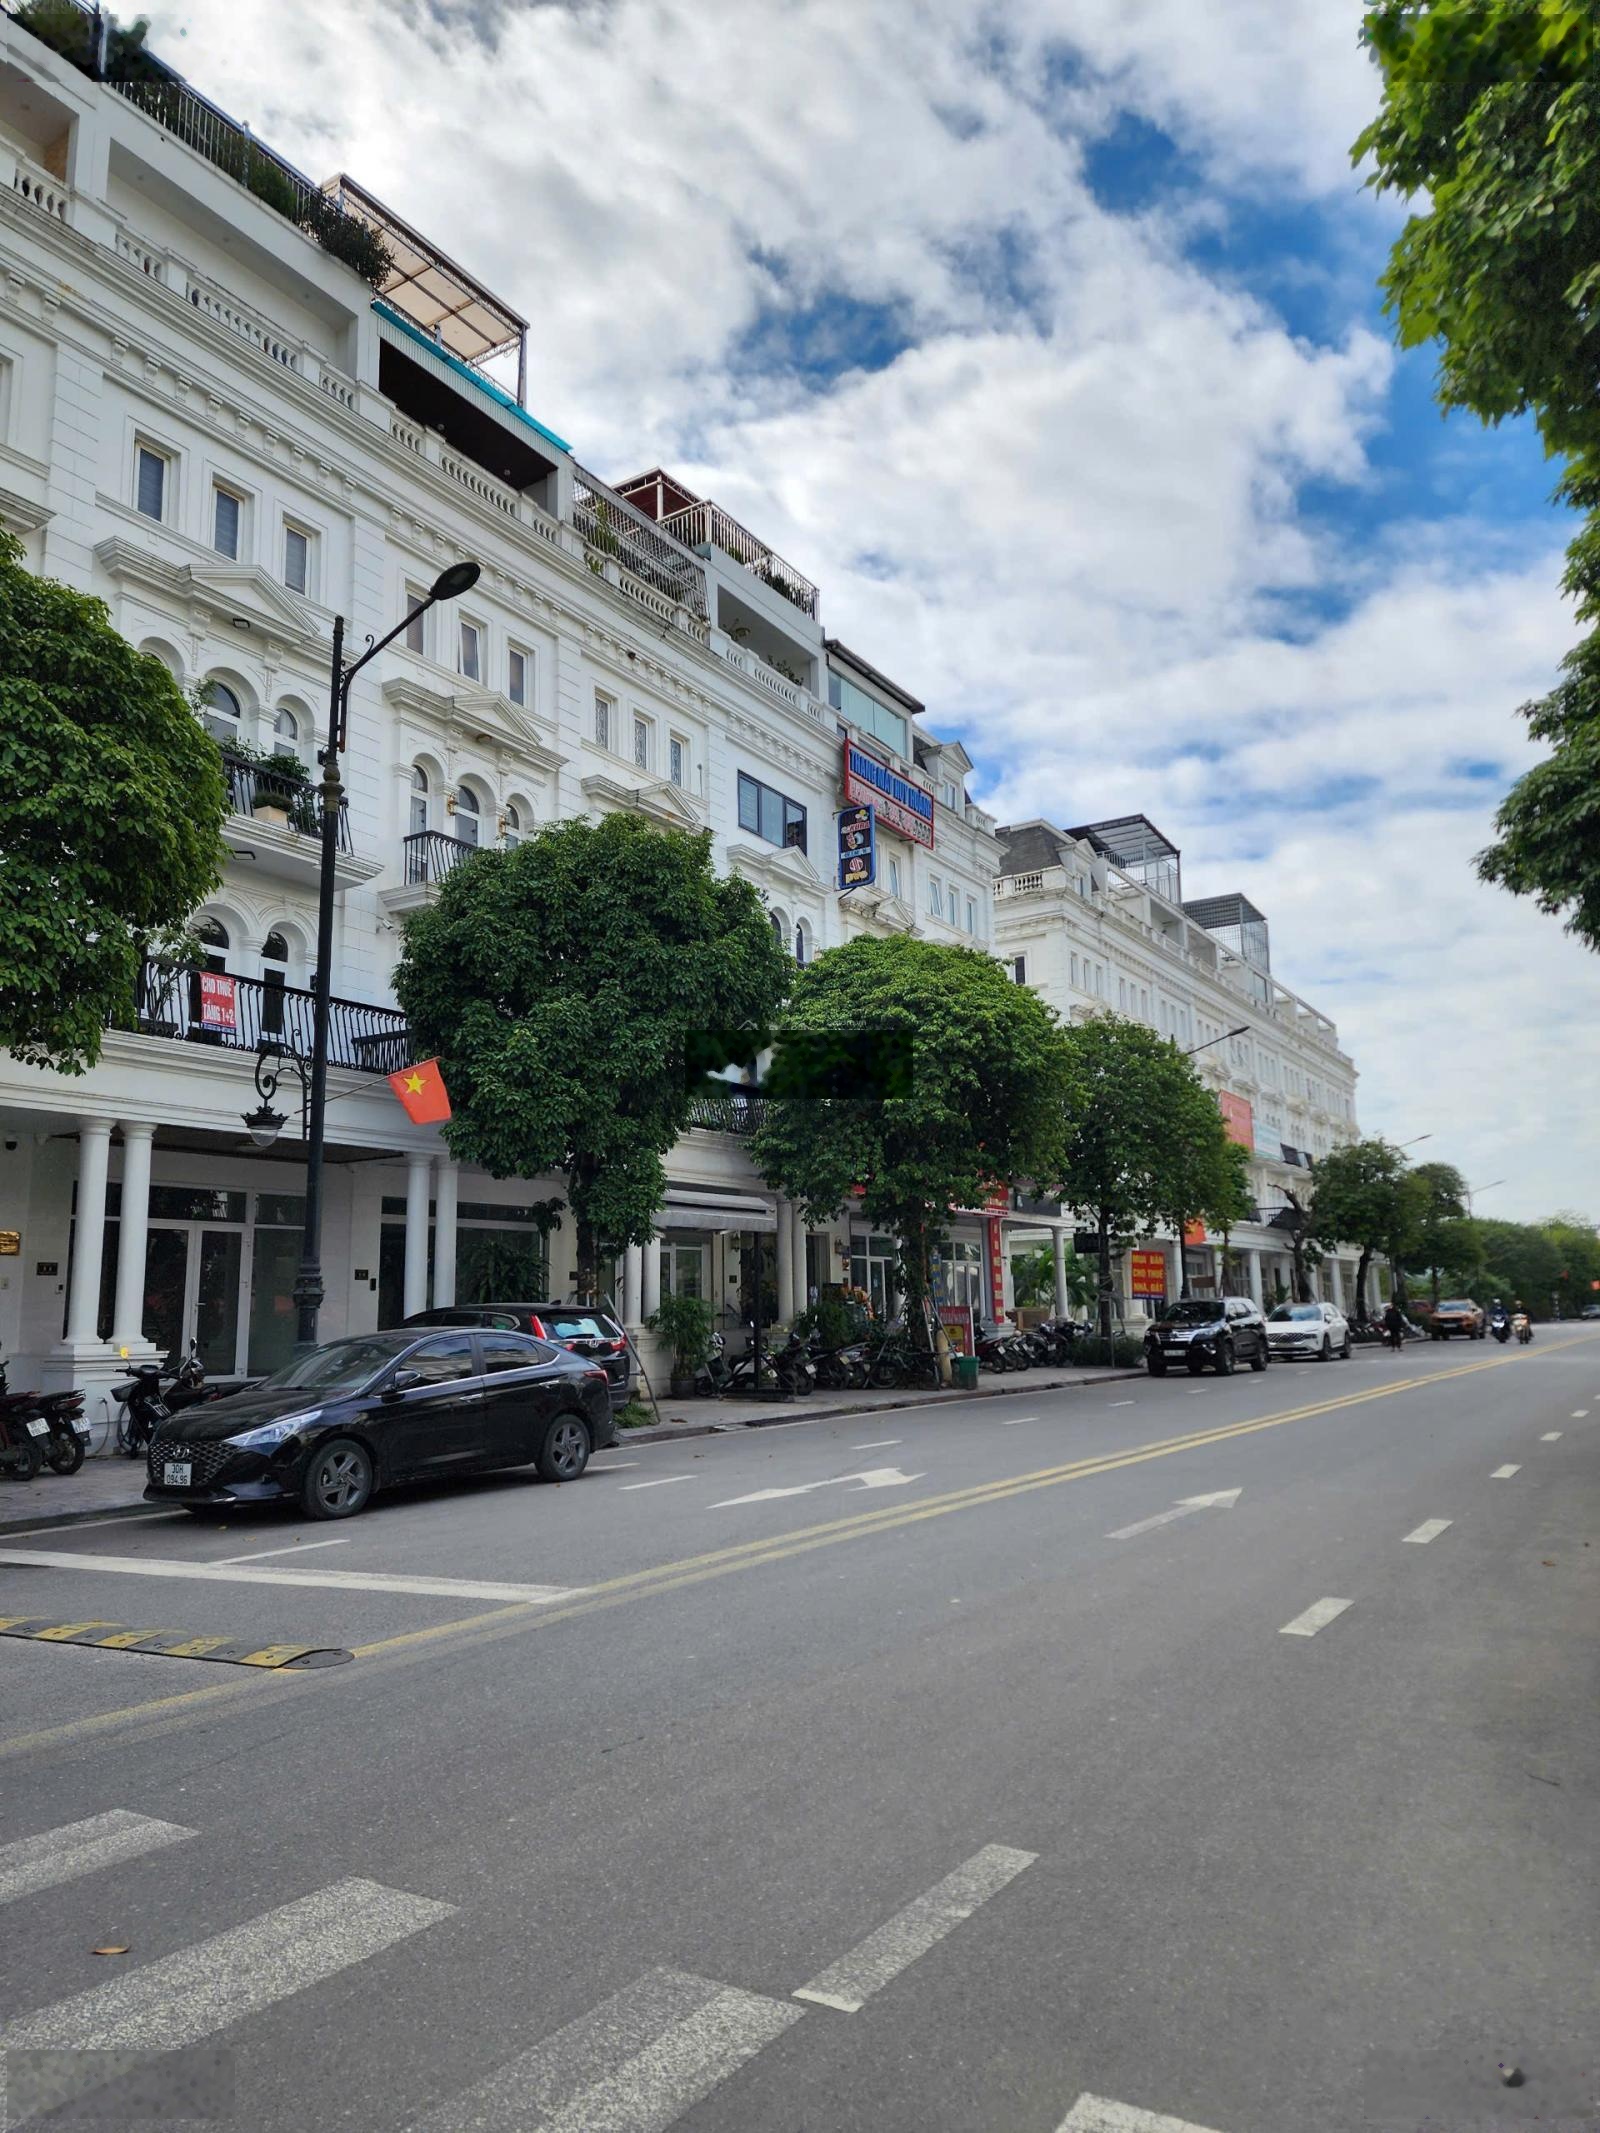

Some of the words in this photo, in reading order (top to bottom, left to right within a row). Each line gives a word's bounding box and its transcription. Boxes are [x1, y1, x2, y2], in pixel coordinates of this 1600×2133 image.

[201, 975, 216, 994] CHO
[217, 978, 233, 998] THUÊ
[221, 1006, 235, 1024] 1+2
[171, 1463, 184, 1474] 30H
[166, 1474, 188, 1485] 094.96
